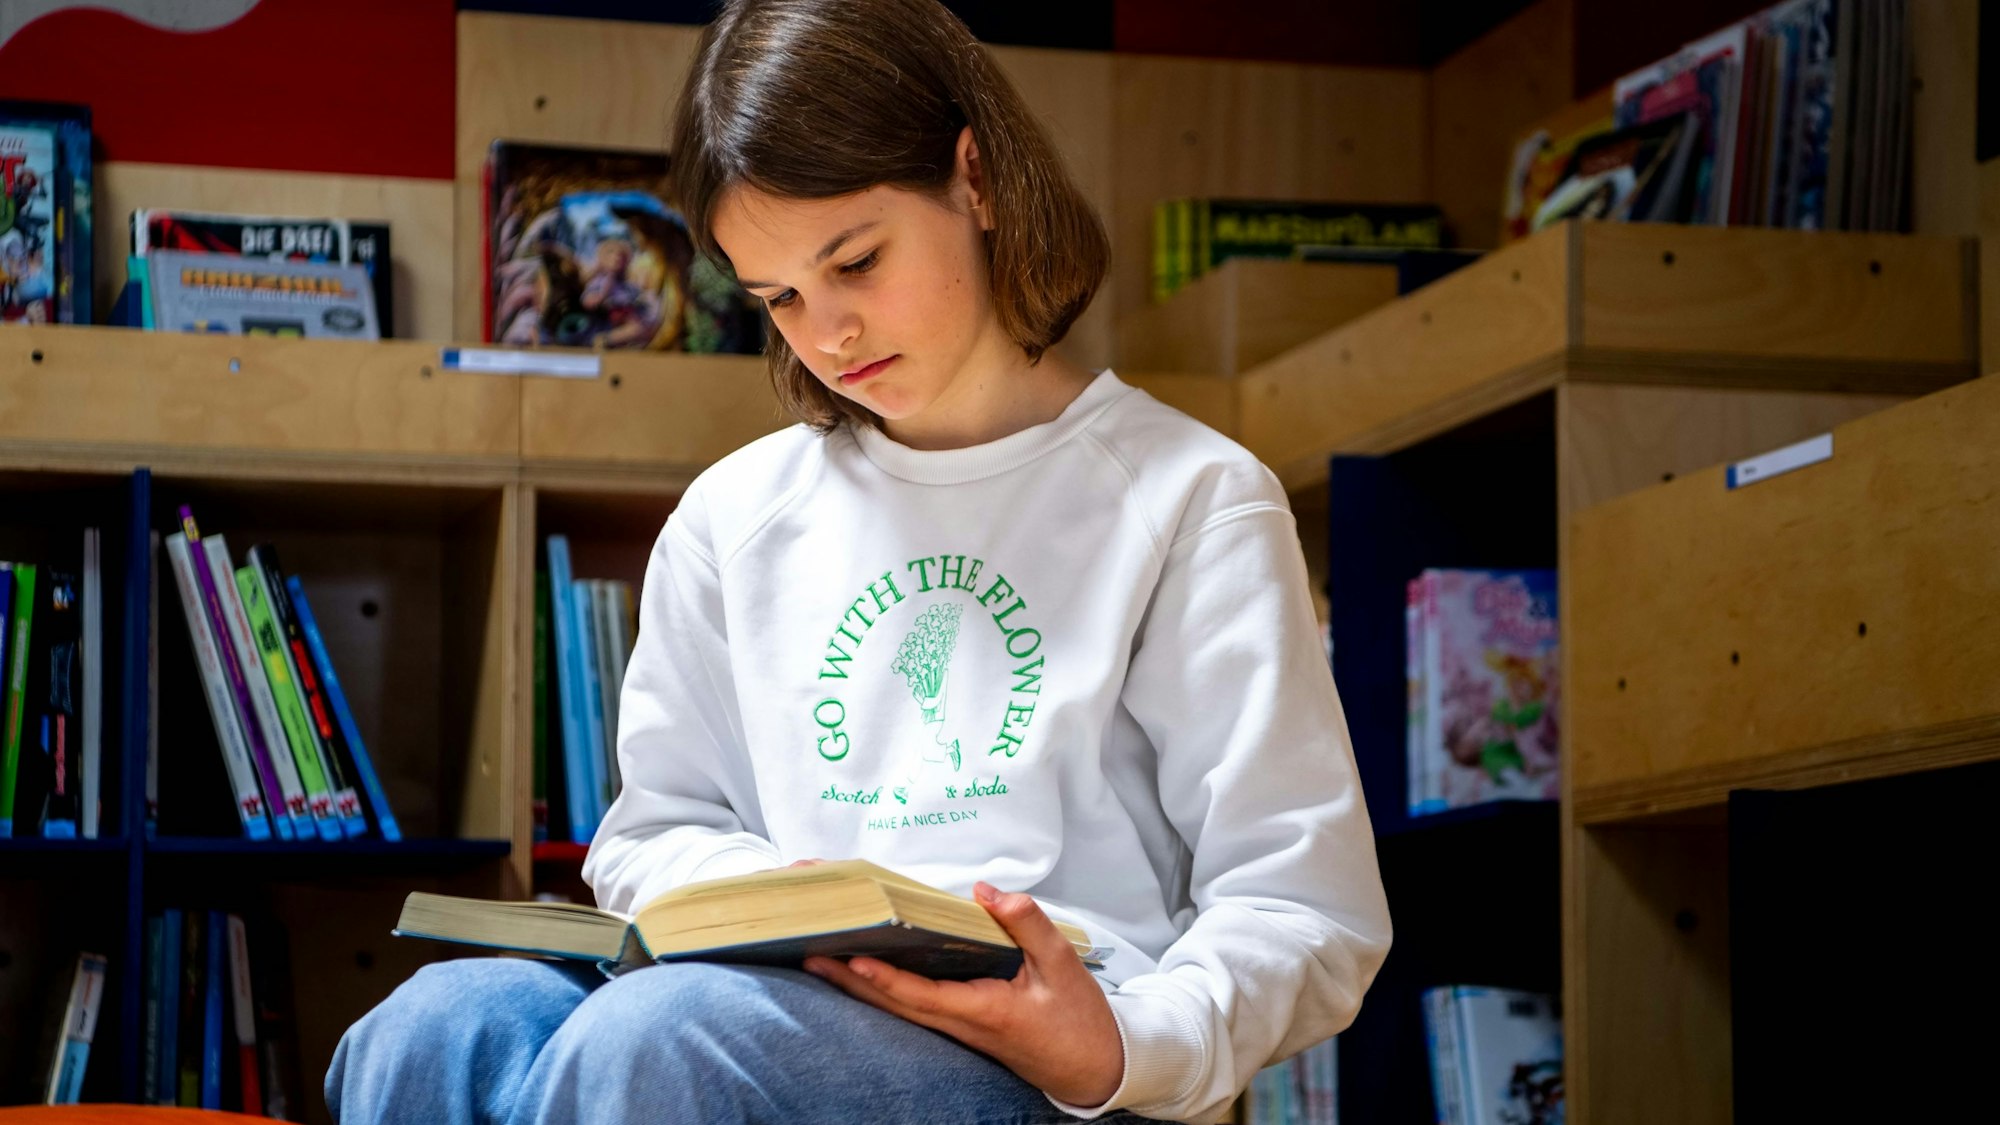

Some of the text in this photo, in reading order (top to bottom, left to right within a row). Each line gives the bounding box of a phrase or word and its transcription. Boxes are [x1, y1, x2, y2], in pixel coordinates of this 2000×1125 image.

[241, 226, 276, 253] DIE
[814, 555, 1044, 761] GO WITH THE FLOWER
[821, 775, 1009, 805] Scotch & Soda
[867, 810, 978, 830] HAVE A NICE DAY
